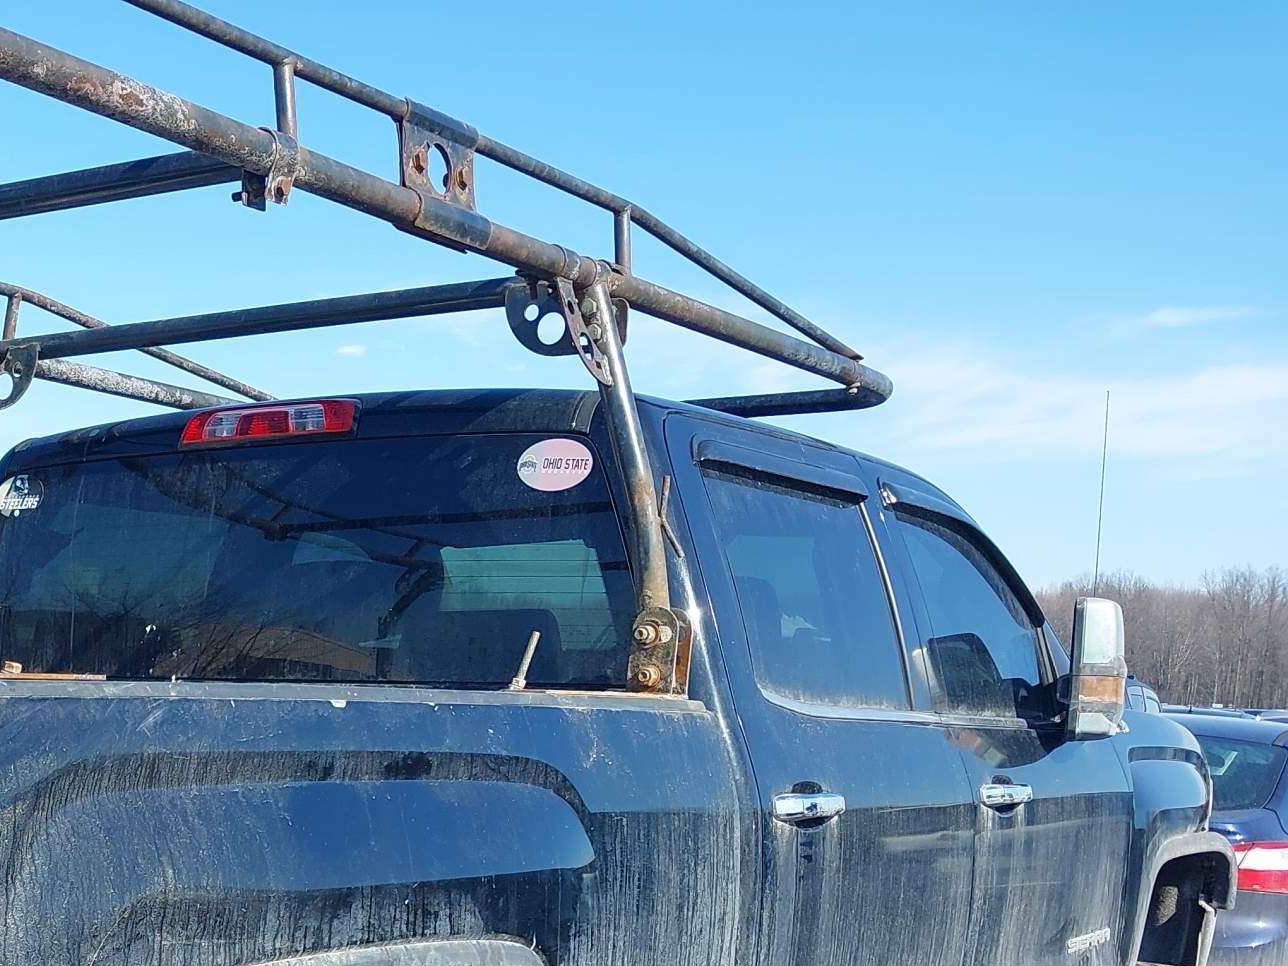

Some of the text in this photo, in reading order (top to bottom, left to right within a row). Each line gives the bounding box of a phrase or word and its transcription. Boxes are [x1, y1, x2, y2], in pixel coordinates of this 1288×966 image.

[542, 457, 563, 470] OHIO
[564, 458, 590, 471] STATE
[0, 497, 40, 510] STEELERS
